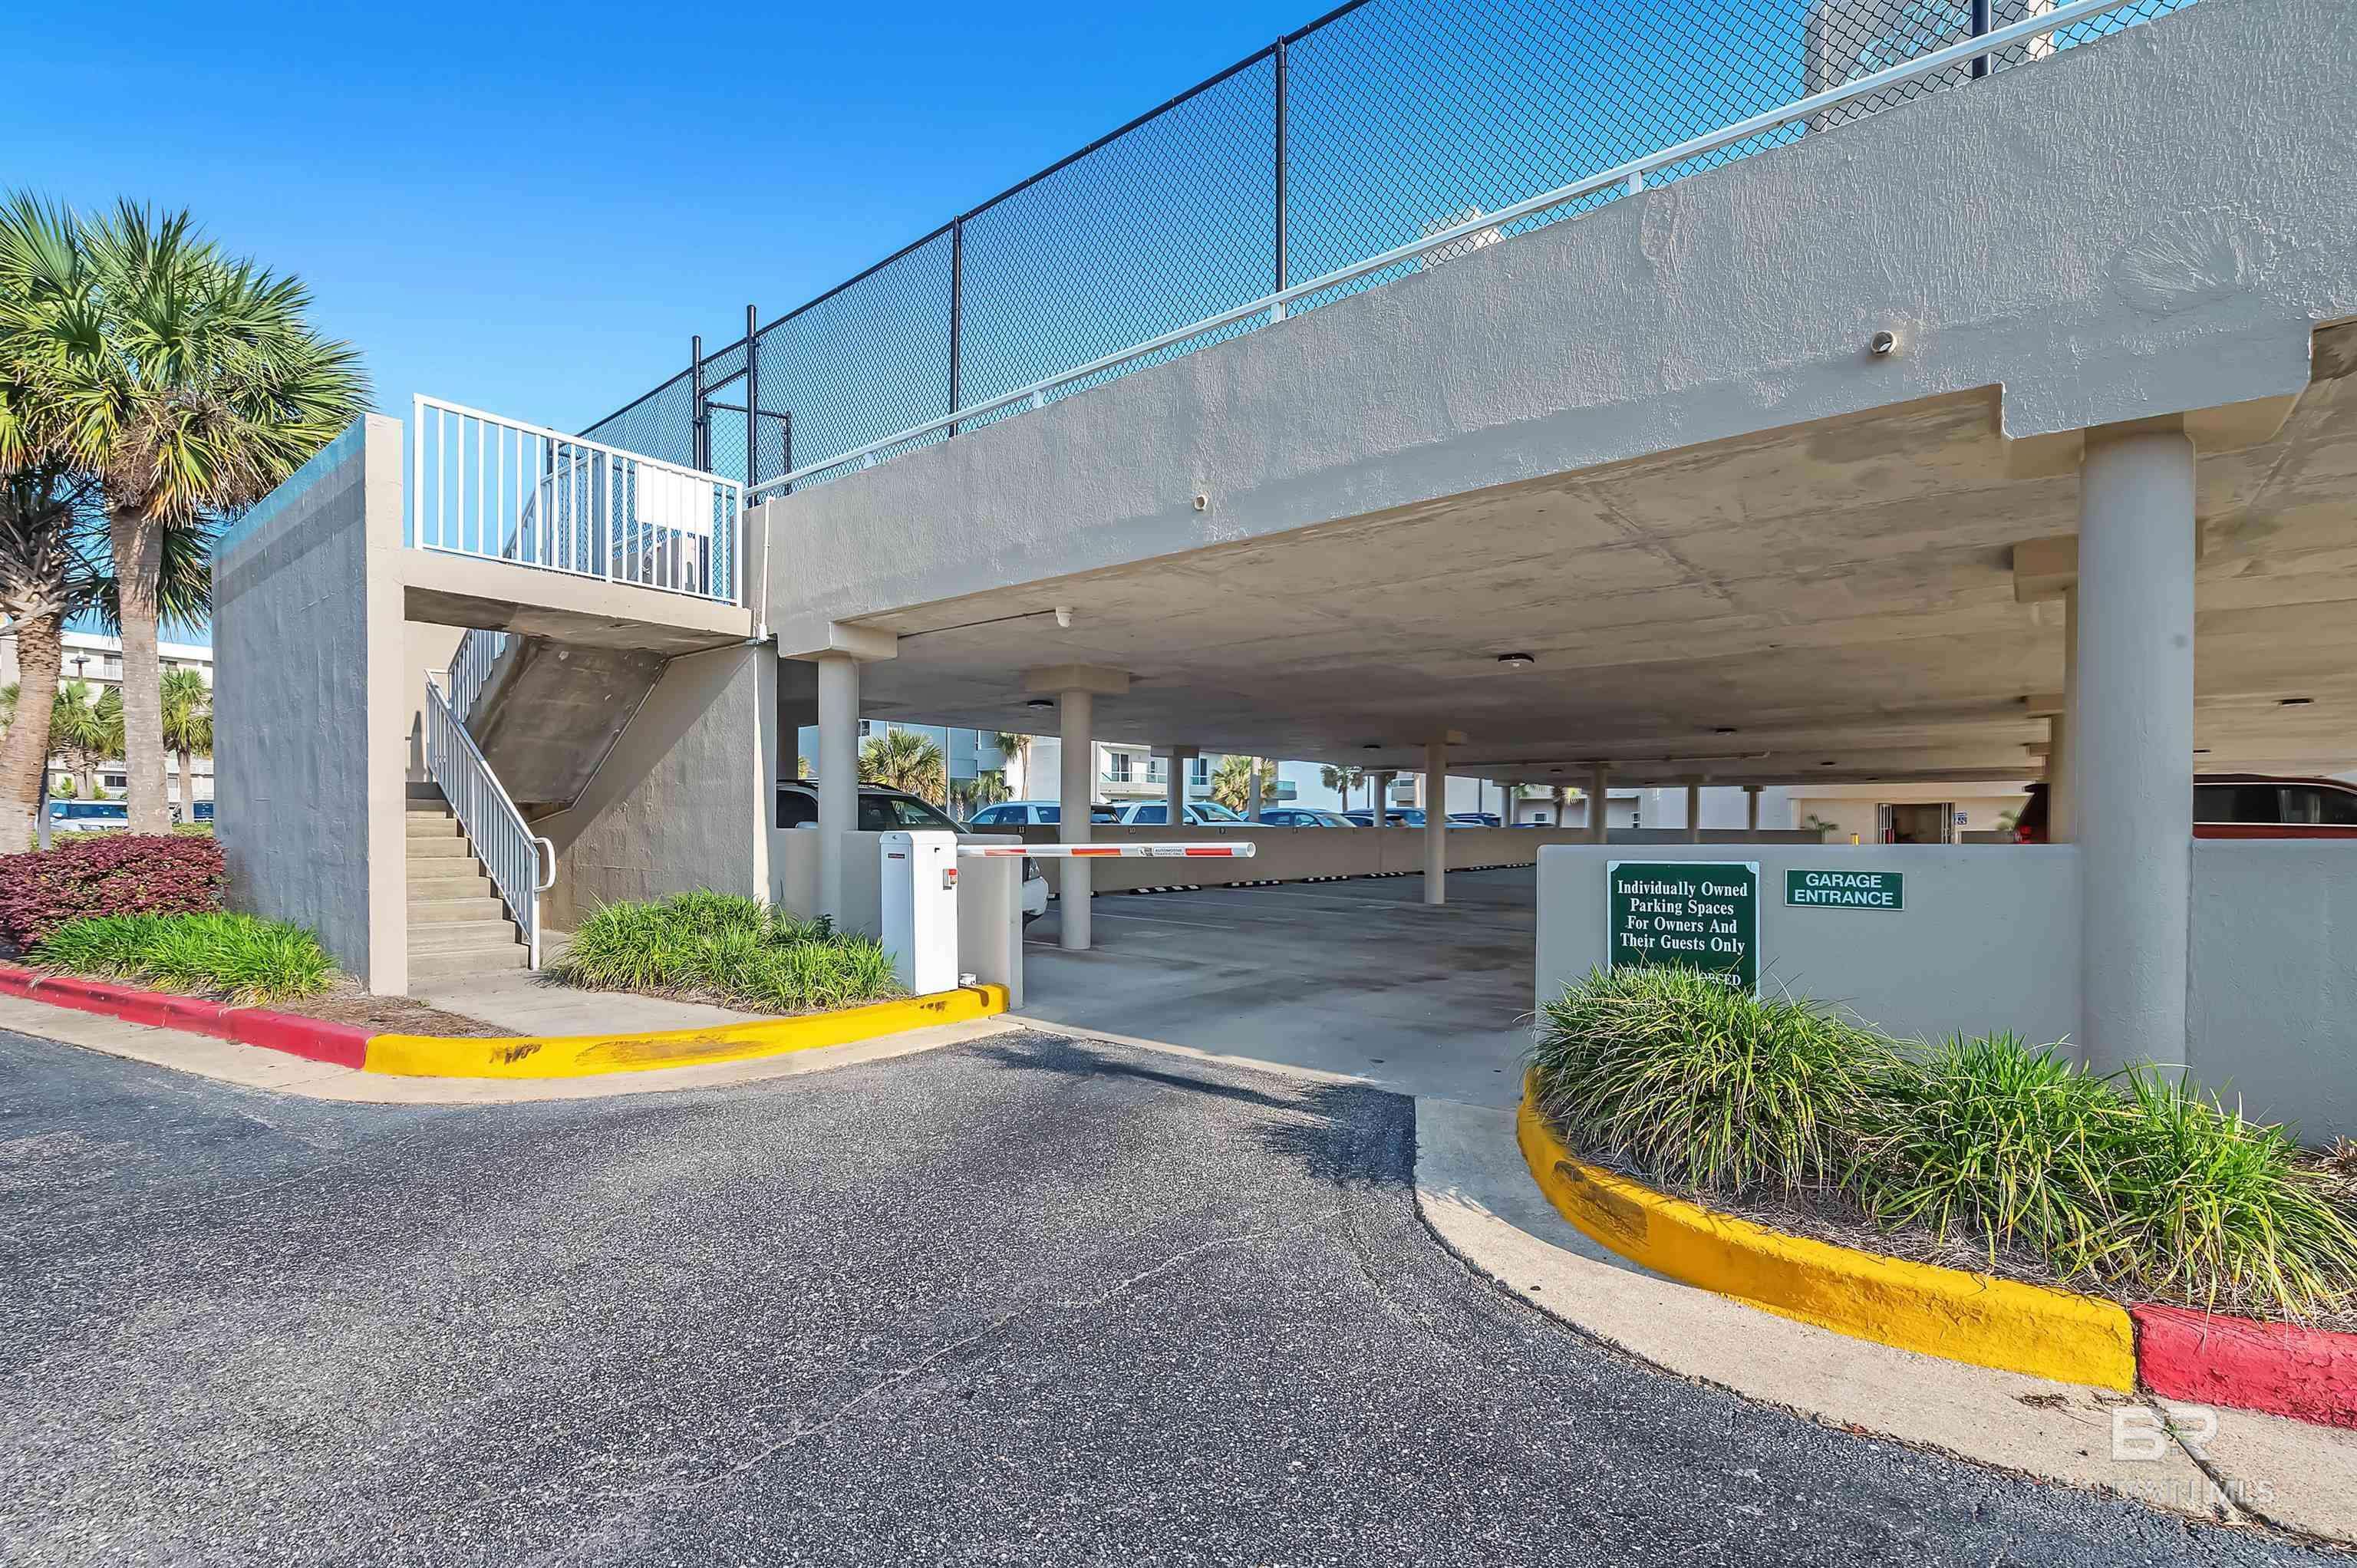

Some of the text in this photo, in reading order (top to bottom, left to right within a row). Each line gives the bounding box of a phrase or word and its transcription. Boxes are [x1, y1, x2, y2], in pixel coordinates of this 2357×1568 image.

[1617, 879, 1748, 898] Individually Owned
[1805, 873, 1882, 888] GARAGE
[1794, 889, 1894, 905] ENTRANCE
[1630, 898, 1735, 917] Parking Spaces
[1627, 915, 1737, 933] For Owners And
[1620, 932, 1745, 955] Their Guests Only
